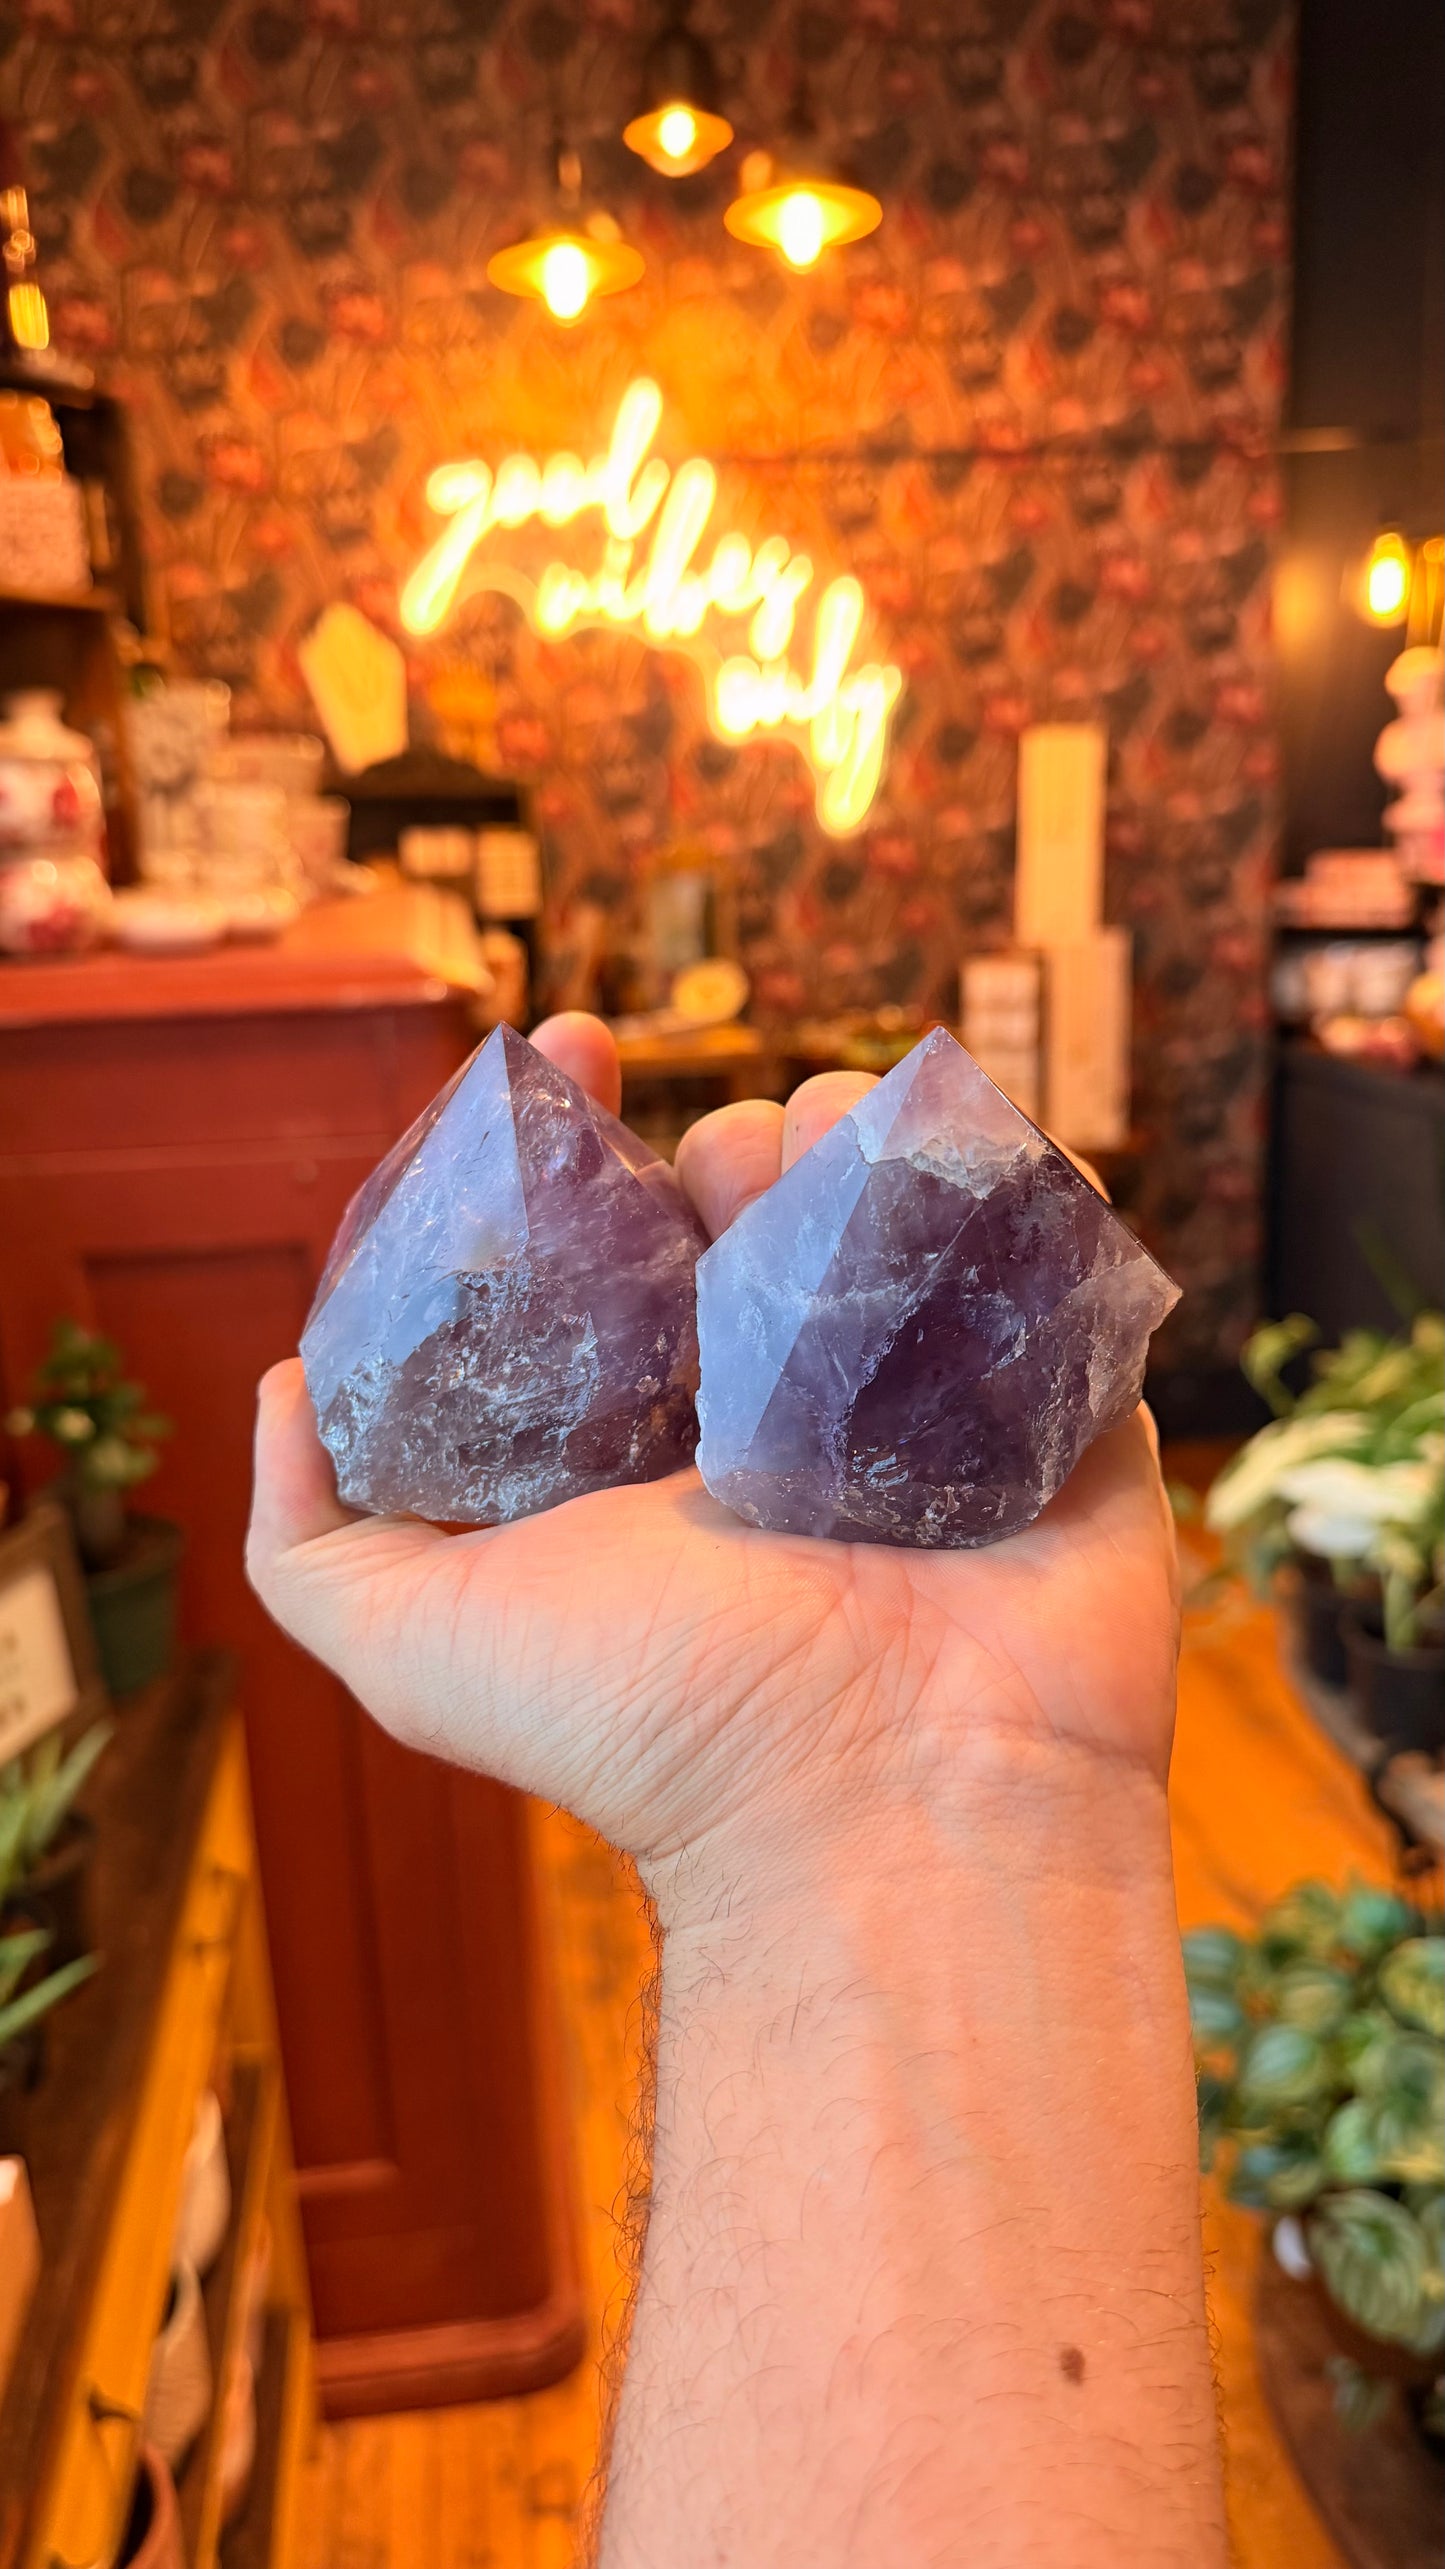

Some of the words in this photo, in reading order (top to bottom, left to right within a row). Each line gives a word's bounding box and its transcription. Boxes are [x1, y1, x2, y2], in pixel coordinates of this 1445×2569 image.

[402, 378, 670, 635] good
[537, 458, 814, 661] vibes
[715, 576, 901, 834] only
